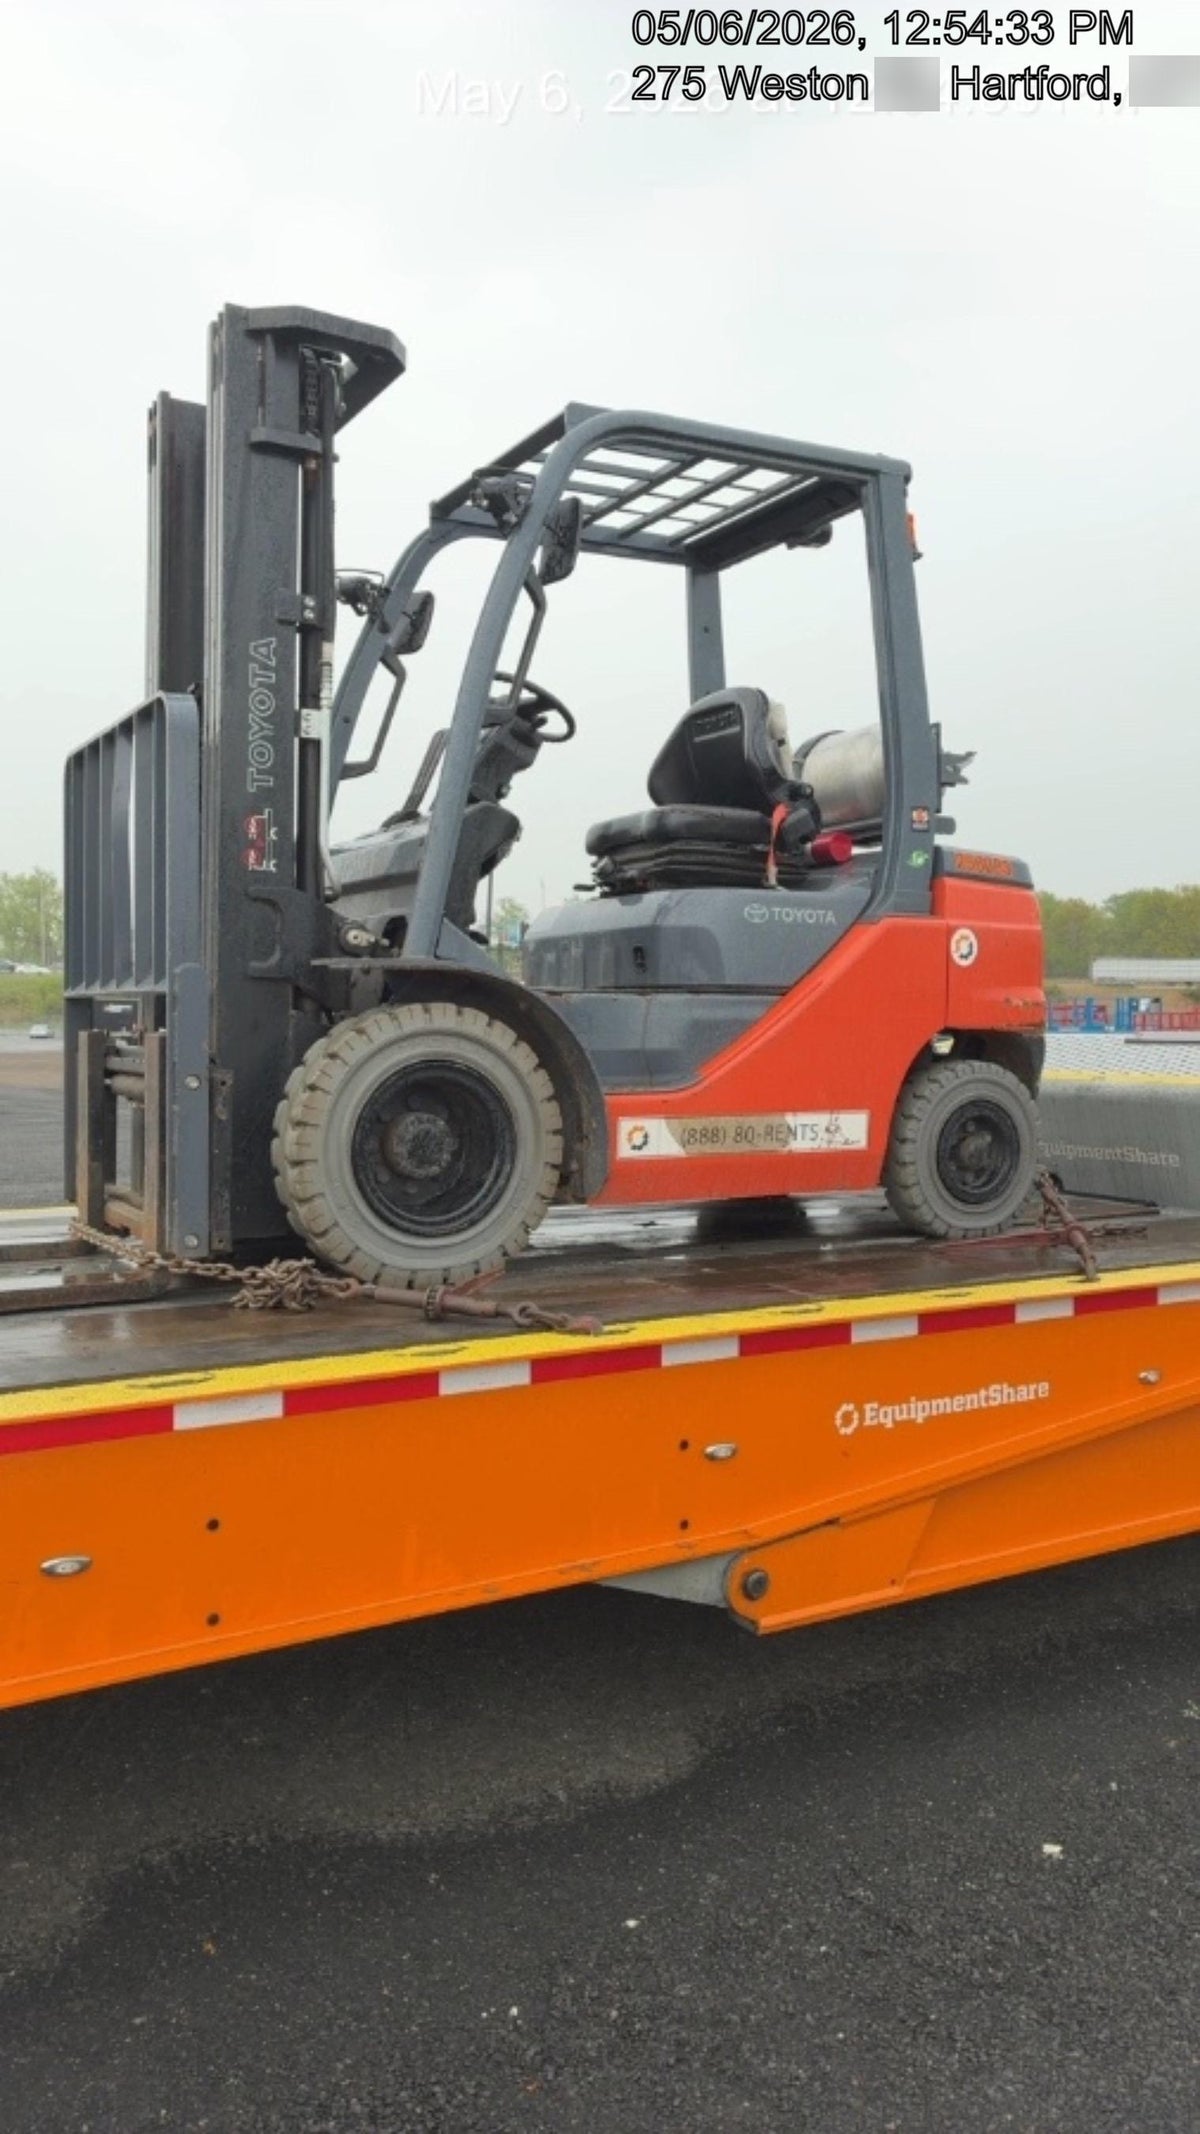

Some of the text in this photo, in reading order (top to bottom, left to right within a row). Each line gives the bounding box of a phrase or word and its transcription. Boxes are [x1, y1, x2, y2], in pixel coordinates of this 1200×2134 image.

[247, 636, 277, 793] TOYOTA
[770, 906, 837, 924] TOYOTA
[680, 1125, 727, 1148] (888)
[1037, 1139, 1181, 1168] quipmentShare
[862, 1380, 1050, 1428] EquipmentShare
